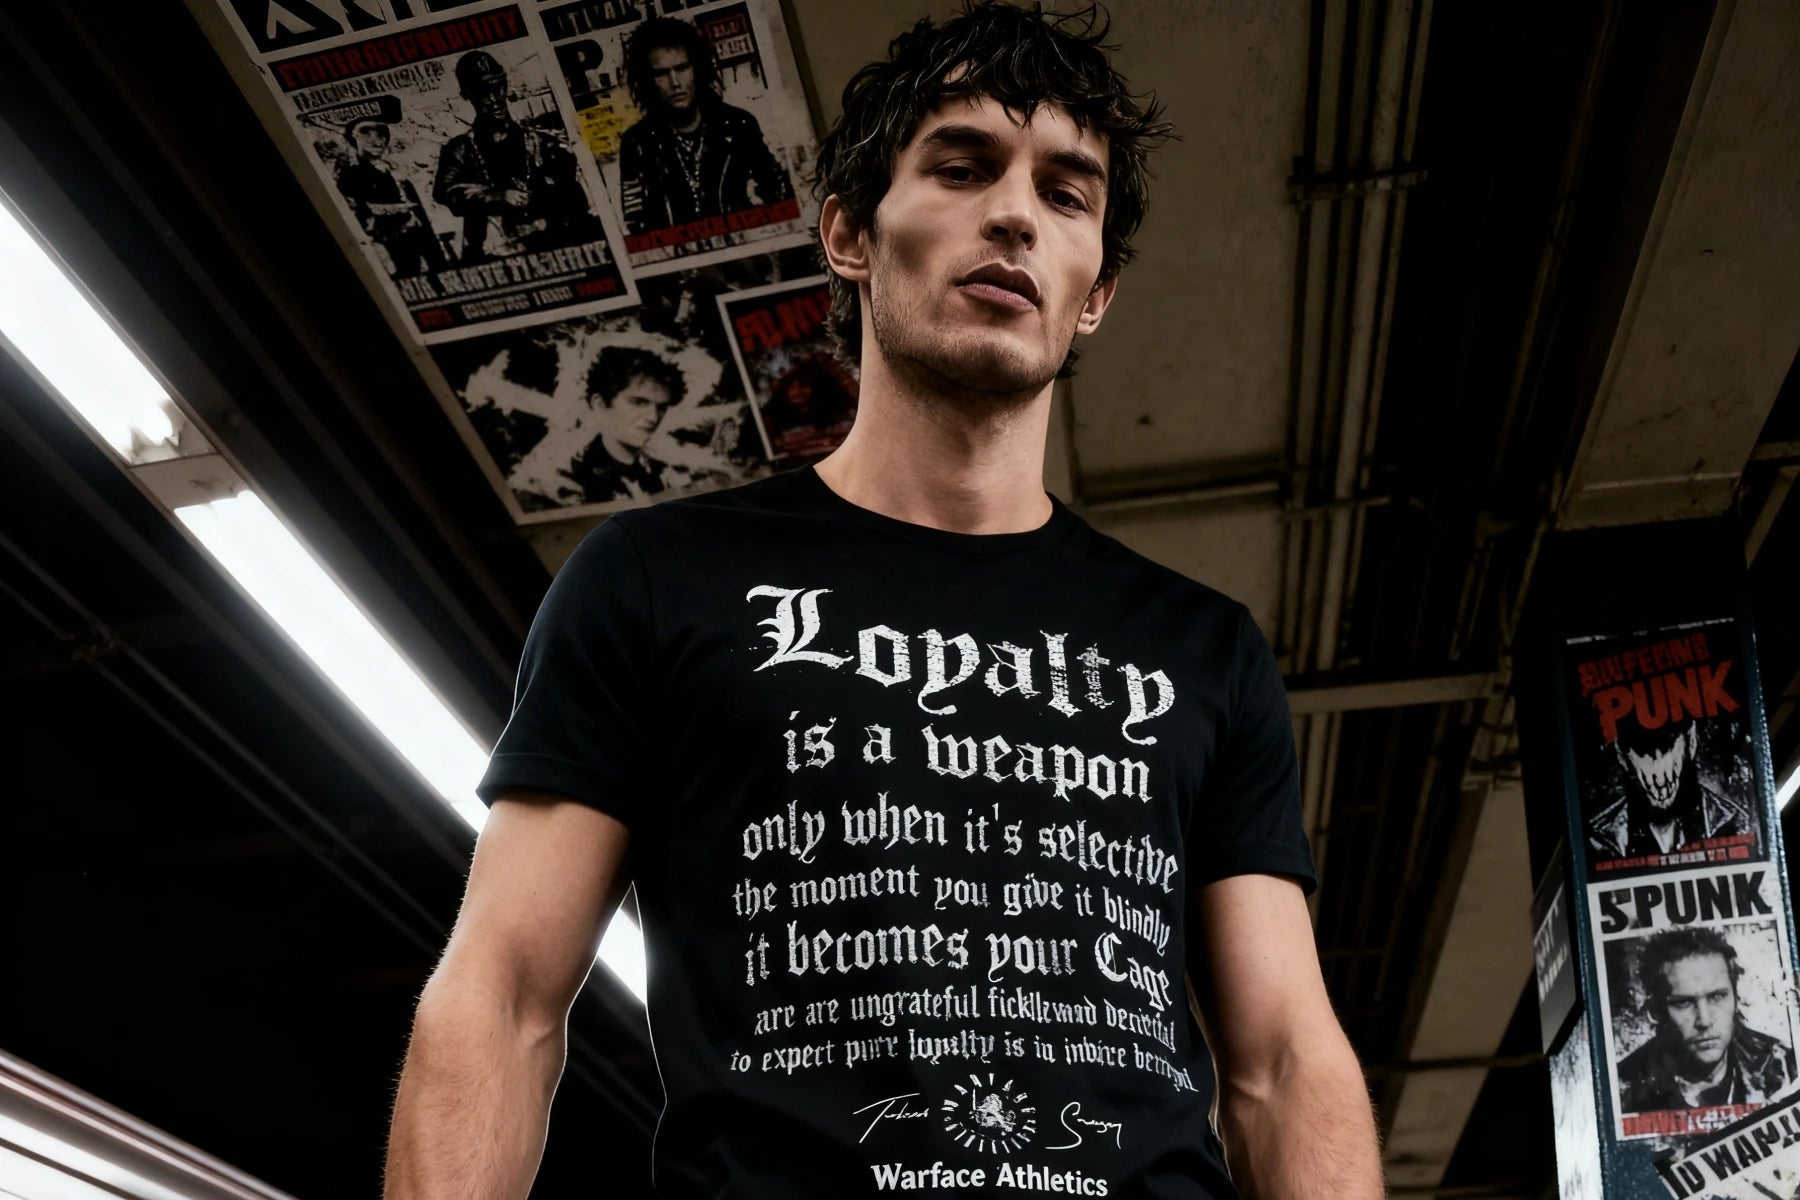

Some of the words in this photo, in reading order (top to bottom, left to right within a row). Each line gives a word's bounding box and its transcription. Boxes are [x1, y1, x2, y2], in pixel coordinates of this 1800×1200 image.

[746, 585, 1175, 746] Loyalty
[1592, 660, 1742, 744] PUNK
[783, 711, 836, 773] is
[863, 724, 896, 764] a
[921, 723, 1152, 803] weapon
[743, 800, 825, 864] only
[842, 791, 948, 849] when
[964, 803, 1022, 855] it's
[1039, 820, 1178, 894] selective
[732, 878, 777, 920] the
[790, 865, 920, 907] moment
[934, 877, 990, 910] you
[1004, 873, 1063, 916] give
[1075, 884, 1094, 916] it
[1103, 886, 1170, 957] blindly
[1598, 871, 1772, 934] SPUNK
[745, 933, 770, 986] it
[787, 920, 968, 976] becomes
[985, 933, 1077, 983] your
[1095, 932, 1173, 1011] Cage
[755, 1005, 794, 1035] are
[806, 999, 839, 1025] are
[851, 985, 980, 1026] ungrateful
[762, 1040, 835, 1075] expect
[1004, 1031, 1025, 1057] is
[871, 1161, 985, 1190] Warface
[996, 1163, 1108, 1197] Athletics
